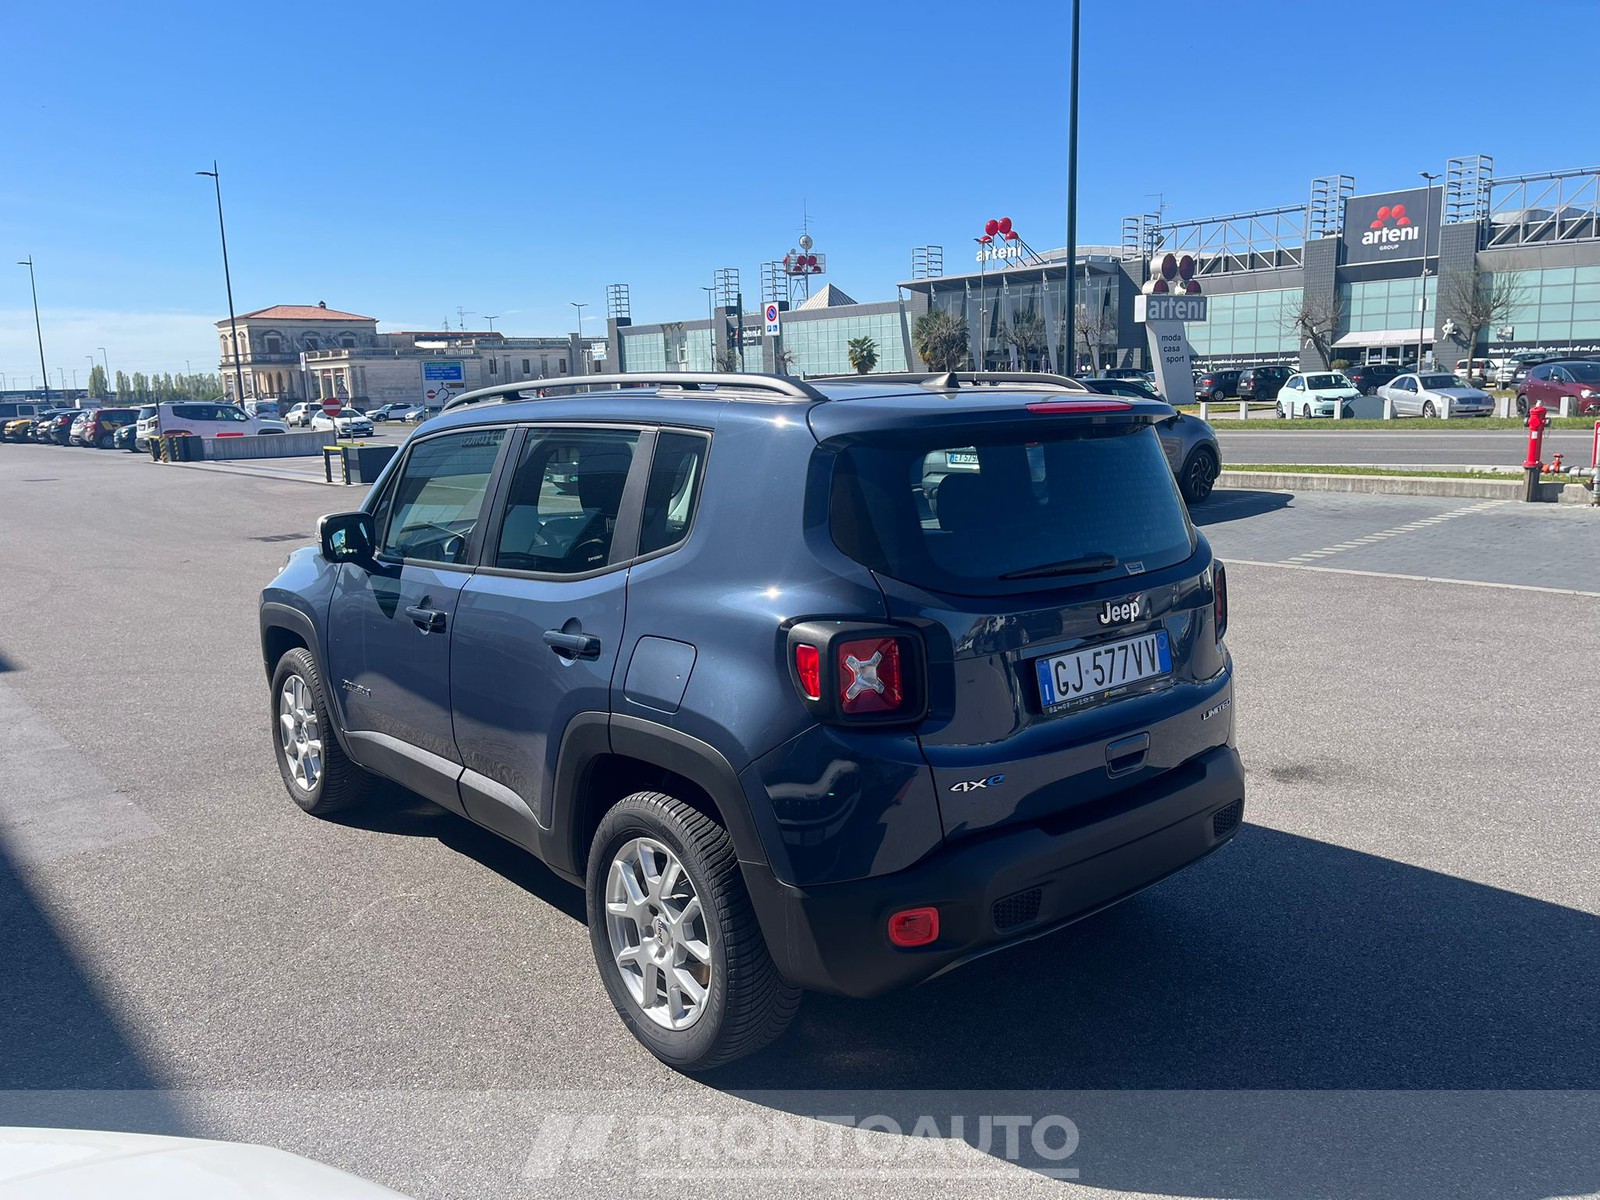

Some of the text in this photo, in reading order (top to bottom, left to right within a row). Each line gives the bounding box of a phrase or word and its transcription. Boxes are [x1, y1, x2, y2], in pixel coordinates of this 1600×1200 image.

[1361, 226, 1419, 245] arteni
[975, 245, 1022, 262] arteni
[1148, 297, 1204, 319] arteni
[1166, 355, 1185, 364] sport
[1099, 601, 1140, 624] Jeep
